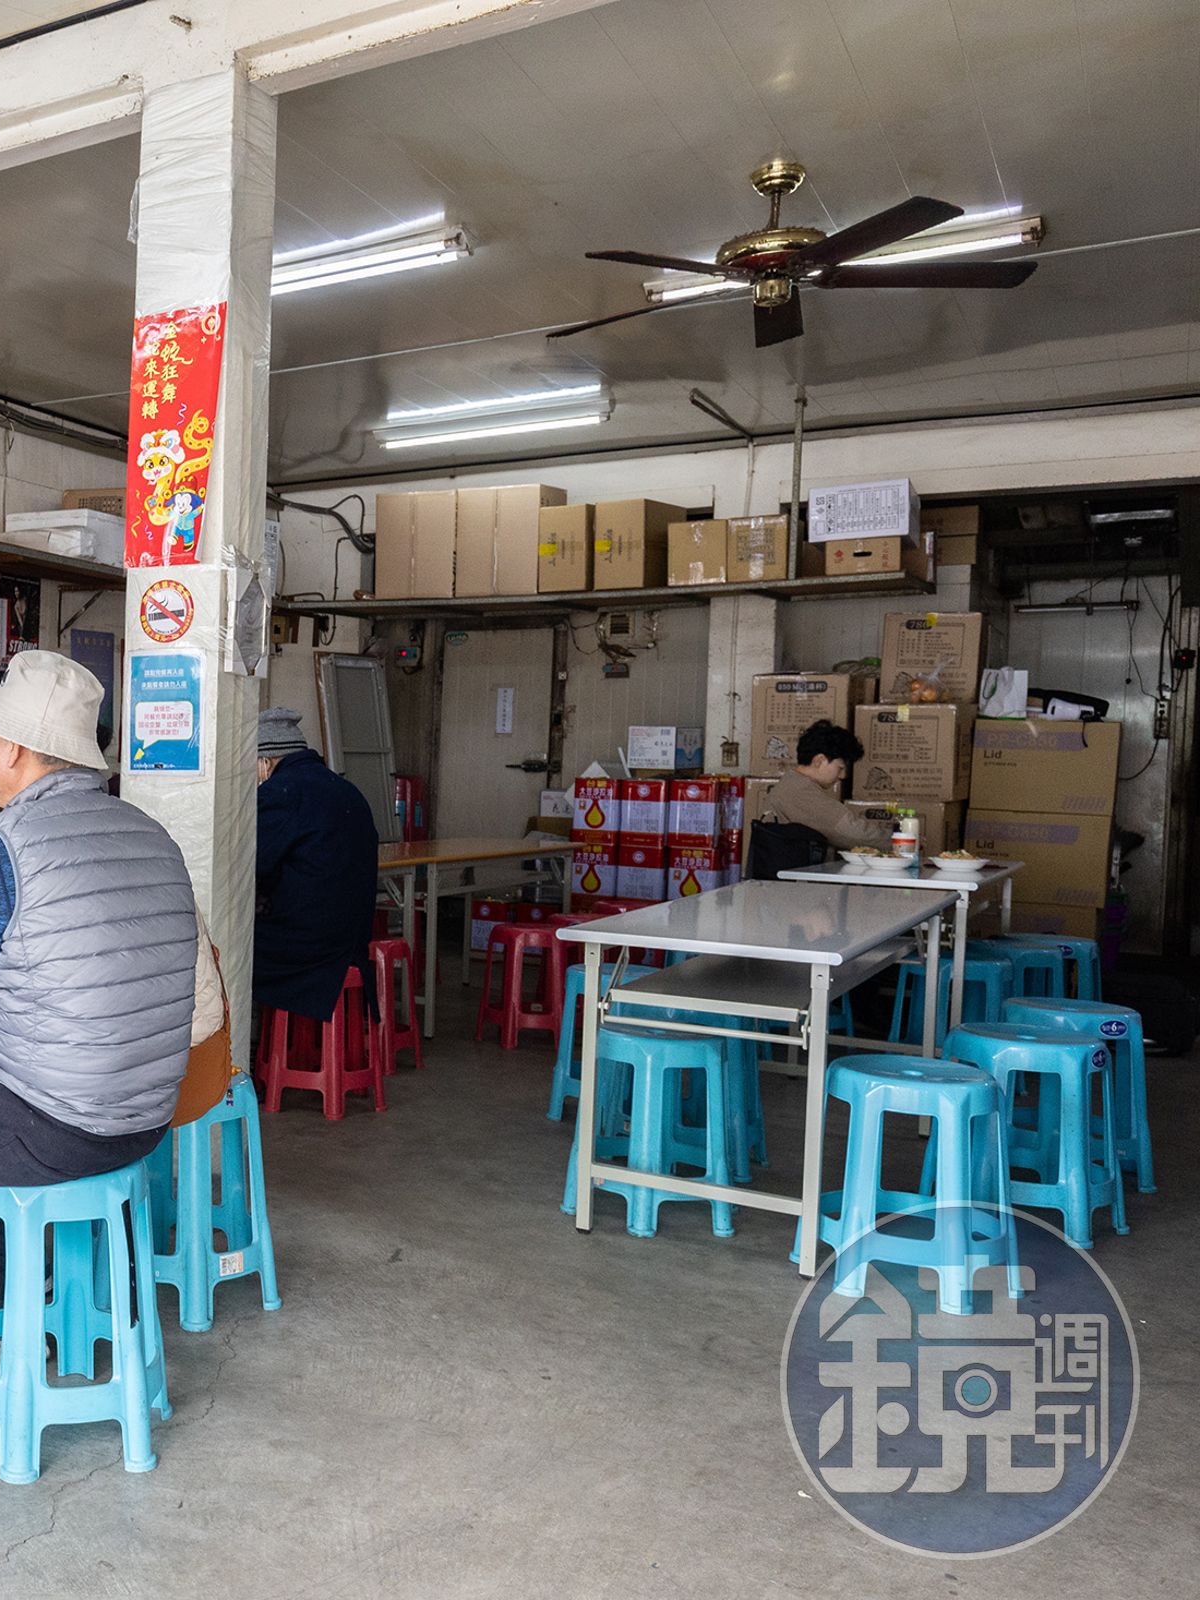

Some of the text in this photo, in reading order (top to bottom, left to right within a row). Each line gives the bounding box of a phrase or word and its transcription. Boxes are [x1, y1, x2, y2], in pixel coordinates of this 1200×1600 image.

[984, 750, 1002, 759] Lid
[976, 840, 994, 849] Lid
[1111, 1022, 1117, 1032] 6
